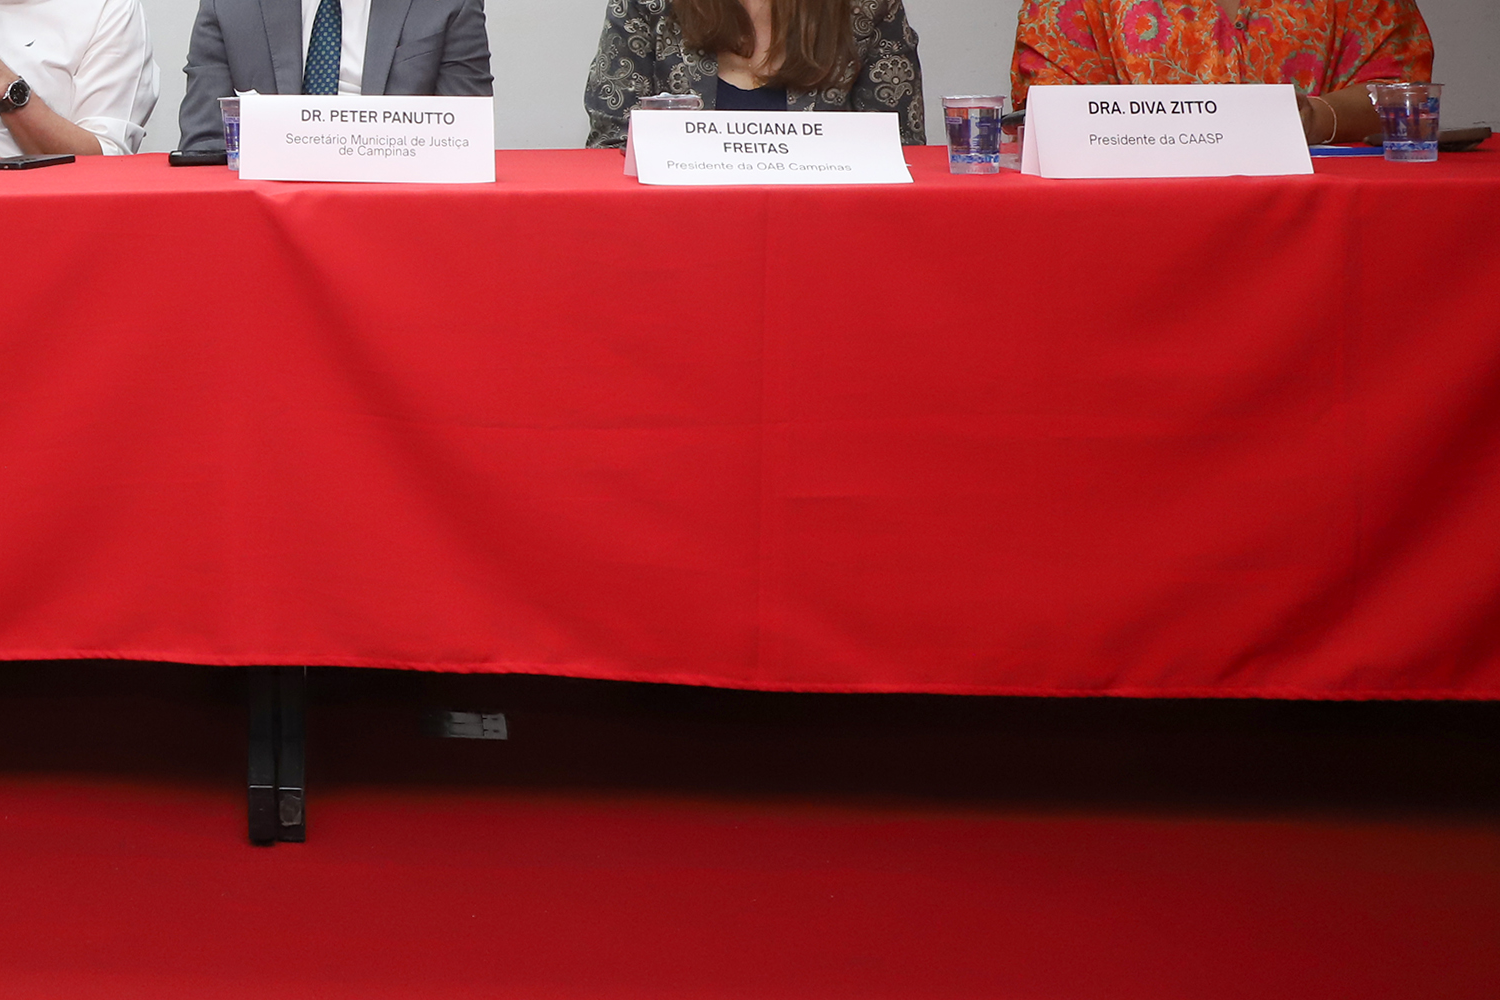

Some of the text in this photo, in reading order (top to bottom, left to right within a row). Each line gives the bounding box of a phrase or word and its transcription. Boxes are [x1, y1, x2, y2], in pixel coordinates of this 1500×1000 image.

[1088, 99, 1218, 116] DRA. DIVA ZITTO
[301, 109, 456, 125] DR. PETER PANUTTO
[684, 121, 824, 136] DRA. LUCIANA DE
[285, 133, 470, 149] Secretário Municipal de Justiça
[1089, 132, 1224, 146] Presidente da CAASP
[338, 145, 416, 158] de Campinas
[723, 142, 789, 155] FREITAS
[666, 160, 852, 173] Presidente da OAB Campinas
